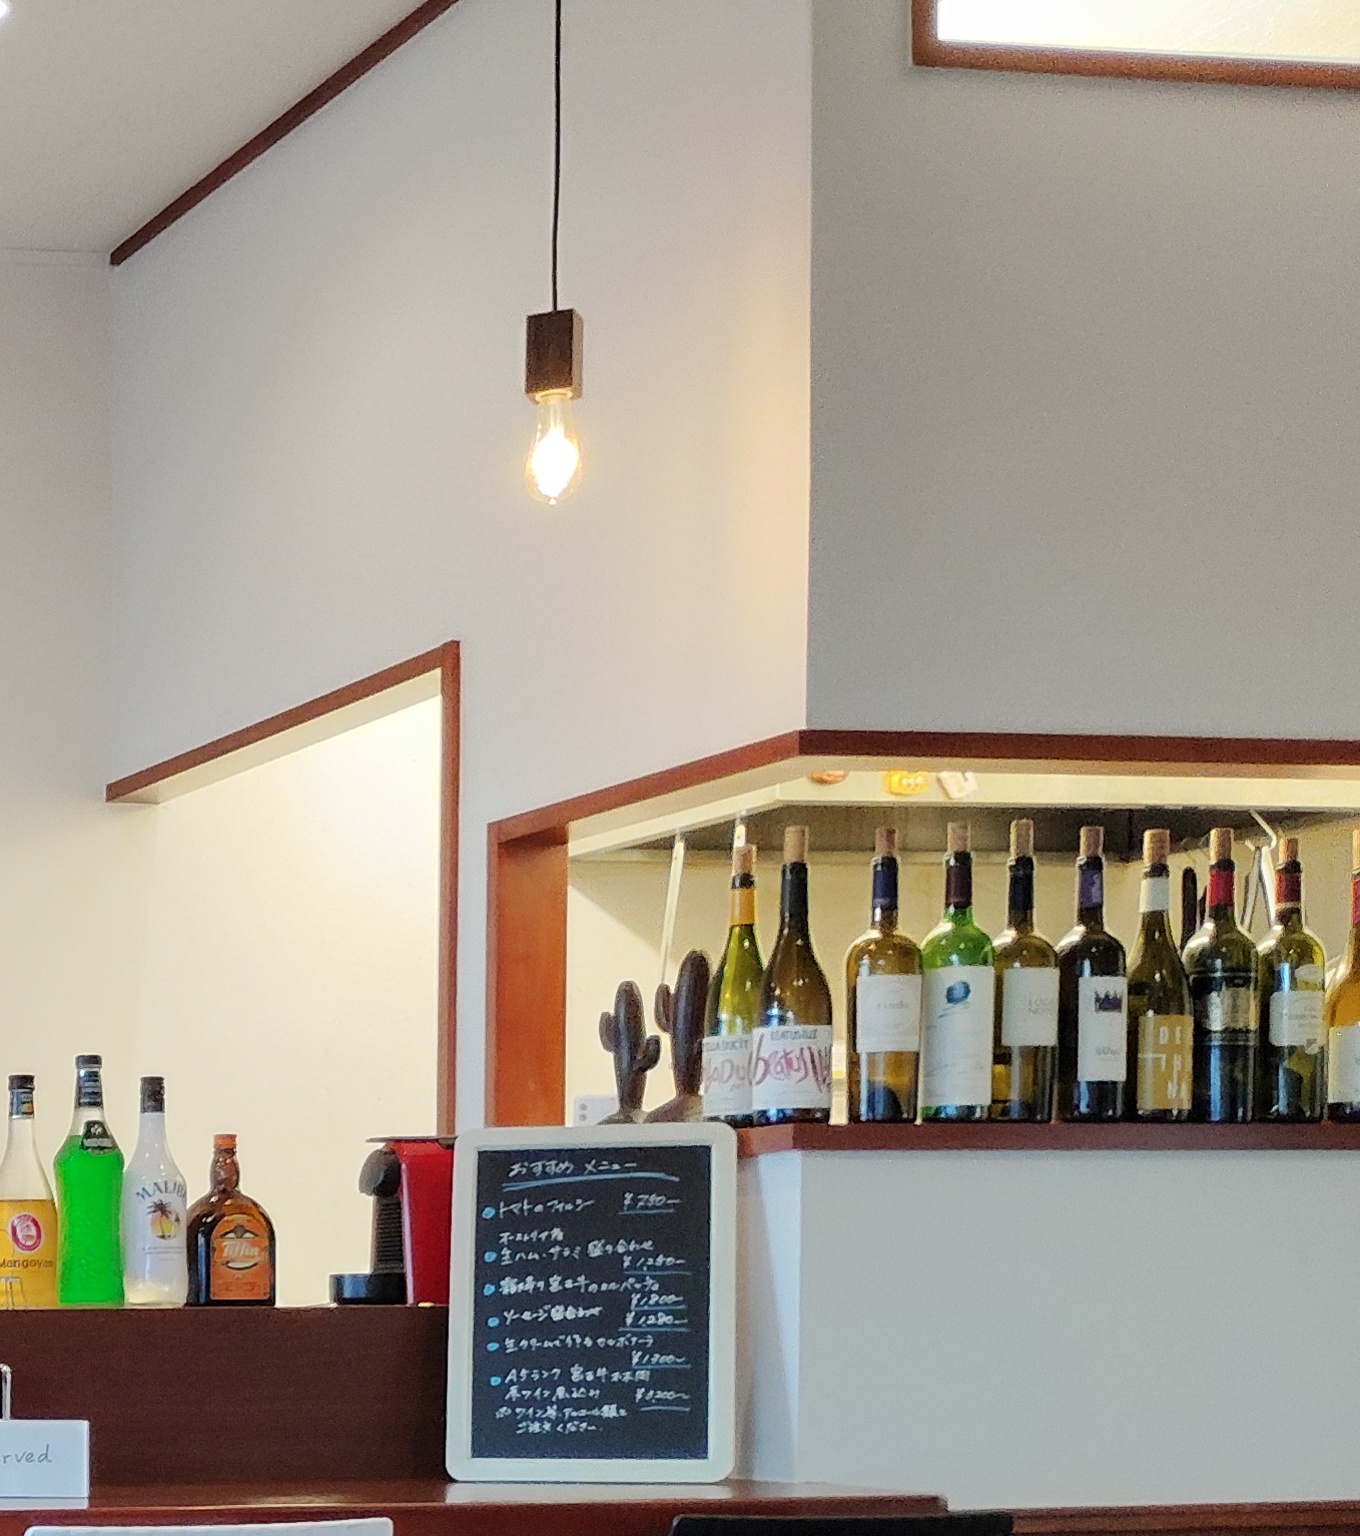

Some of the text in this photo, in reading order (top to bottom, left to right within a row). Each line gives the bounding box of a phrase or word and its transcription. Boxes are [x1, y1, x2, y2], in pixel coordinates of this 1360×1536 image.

[508, 1159, 638, 1178] おすすめ メニュー
[136, 1180, 187, 1201] MALIB
